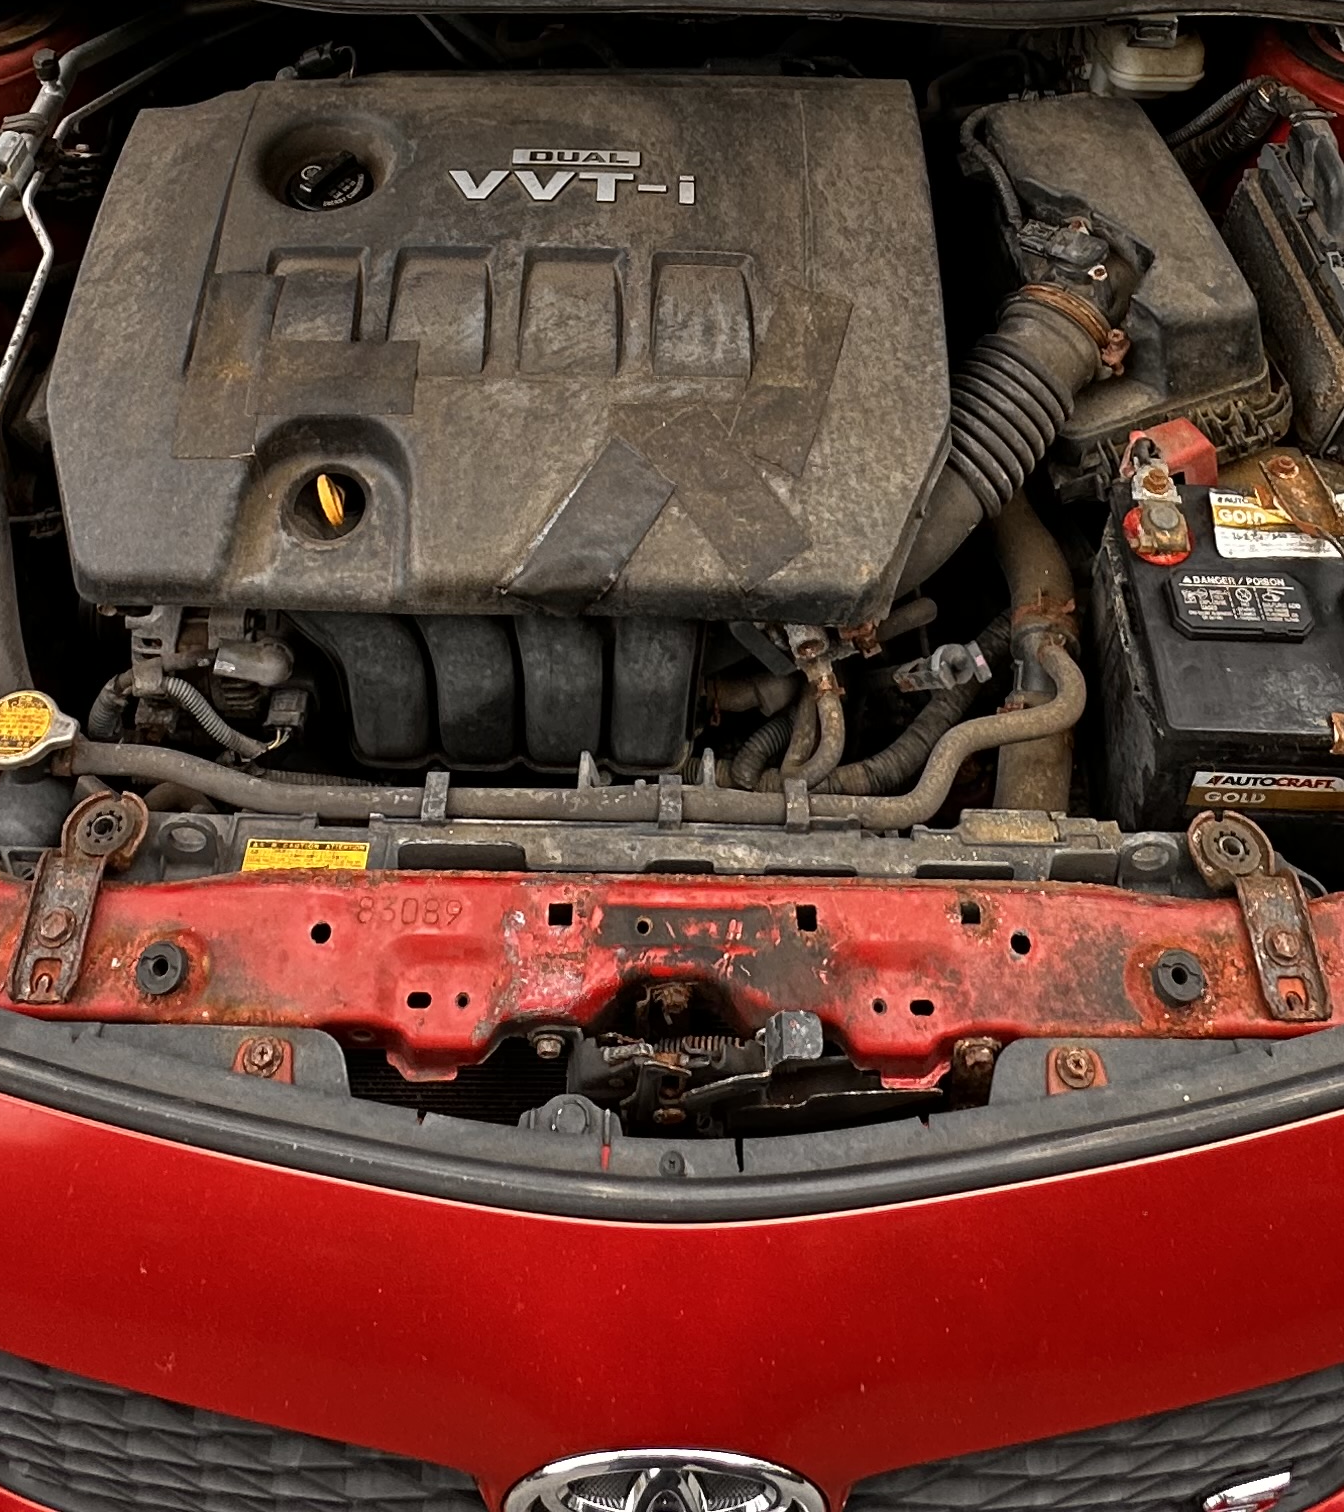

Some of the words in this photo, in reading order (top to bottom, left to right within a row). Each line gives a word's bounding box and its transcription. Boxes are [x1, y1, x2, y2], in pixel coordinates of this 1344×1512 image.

[529, 150, 630, 164] DUAL
[448, 170, 696, 205] VVT-i
[1191, 575, 1236, 586] DANGER
[1245, 576, 1286, 587] POISON
[1220, 775, 1336, 789] AUTOCRAFT
[1203, 791, 1267, 804] GOLD
[356, 896, 463, 926] 83089
